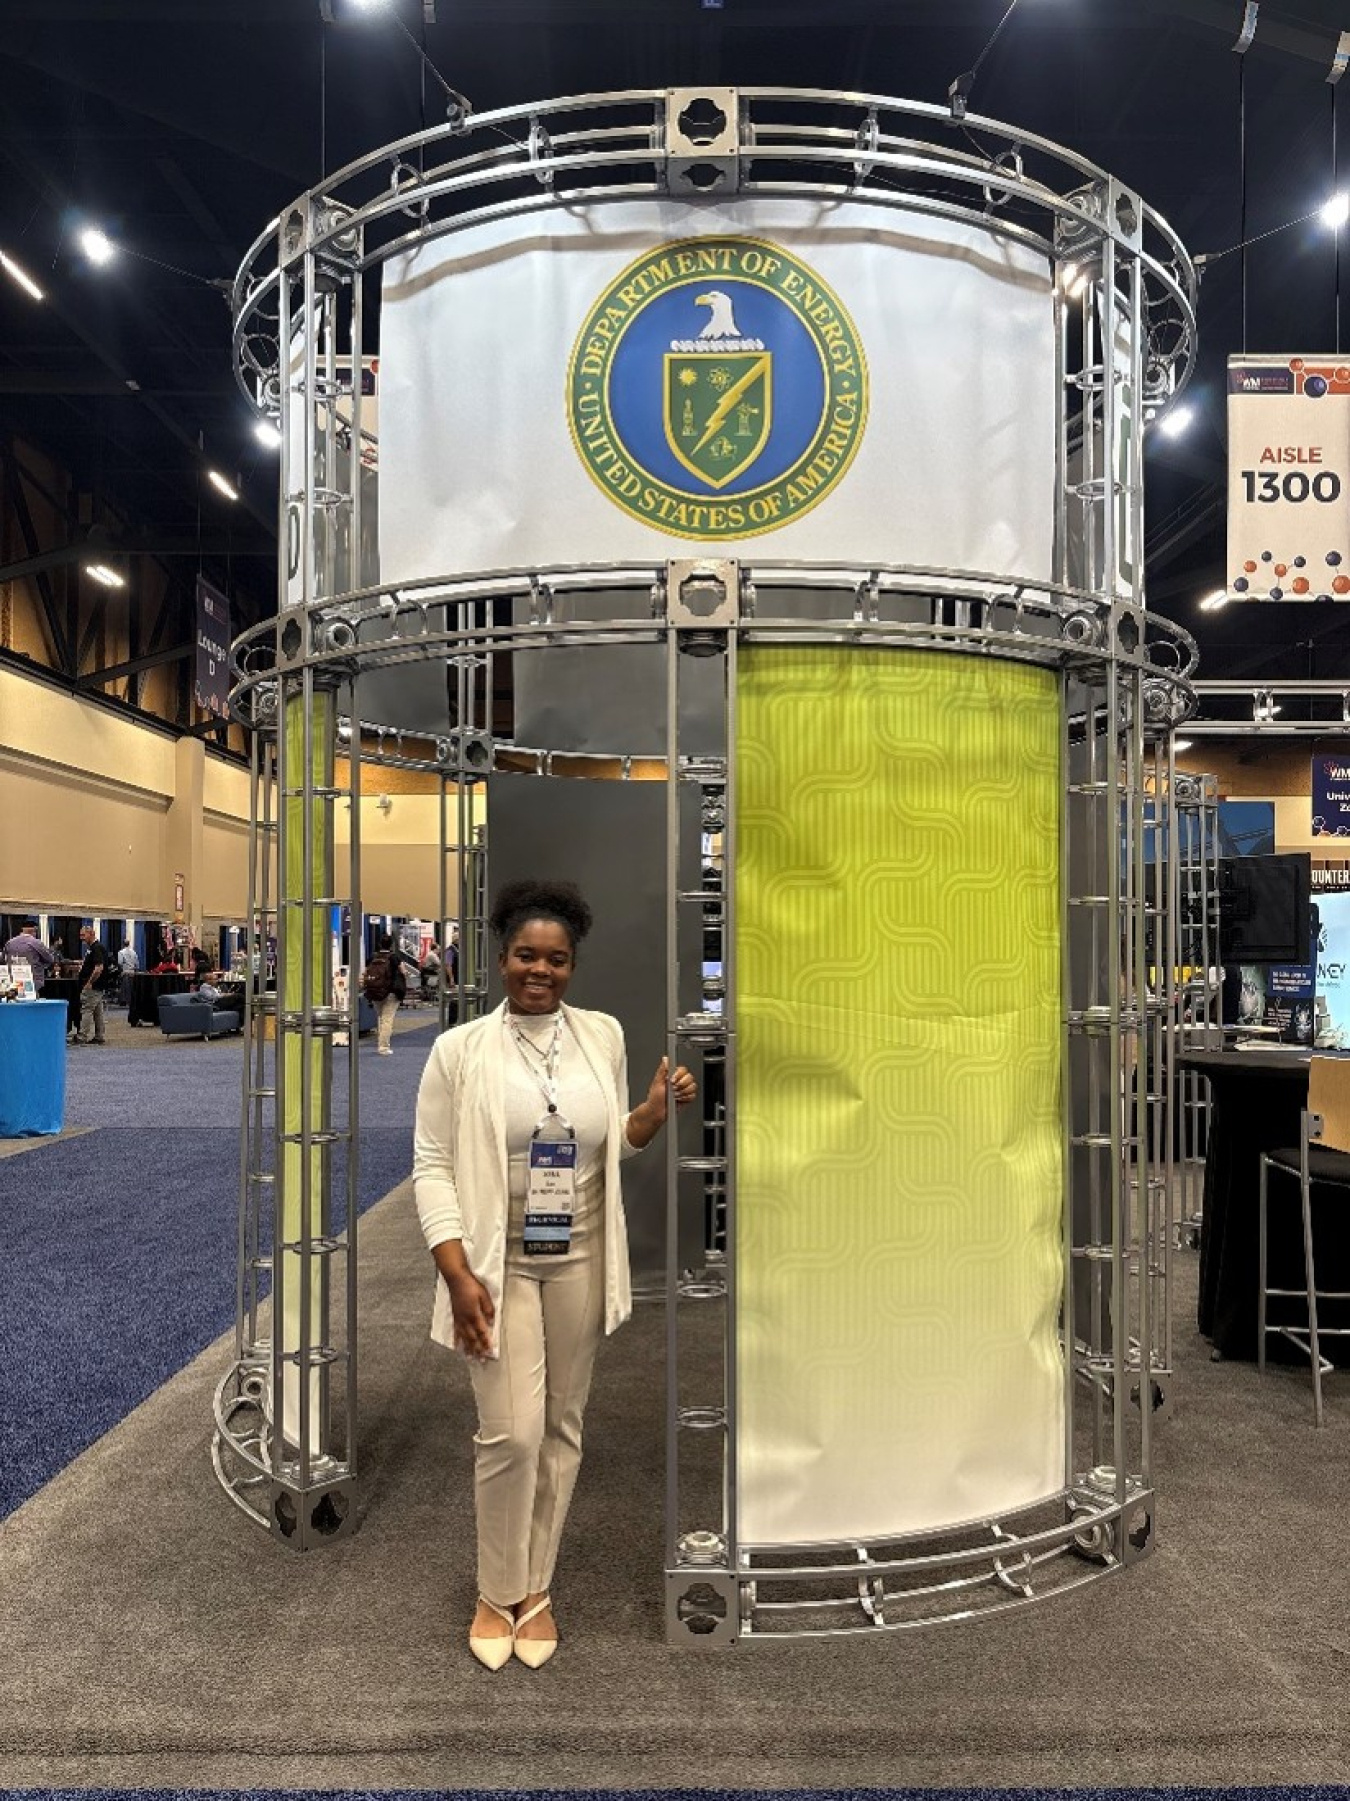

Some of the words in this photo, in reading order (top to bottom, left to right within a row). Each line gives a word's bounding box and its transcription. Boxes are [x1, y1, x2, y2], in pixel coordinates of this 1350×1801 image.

[581, 248, 738, 377] DEPARTMENT
[741, 251, 781, 278] OF
[780, 271, 858, 376] ENERGY
[577, 391, 643, 497] UNITED
[638, 488, 746, 529] STATES
[748, 494, 784, 522] OF
[785, 391, 858, 502] AMERICA
[1259, 446, 1323, 465] AISLE
[1241, 471, 1340, 503] 1300
[197, 629, 227, 662] Lounge
